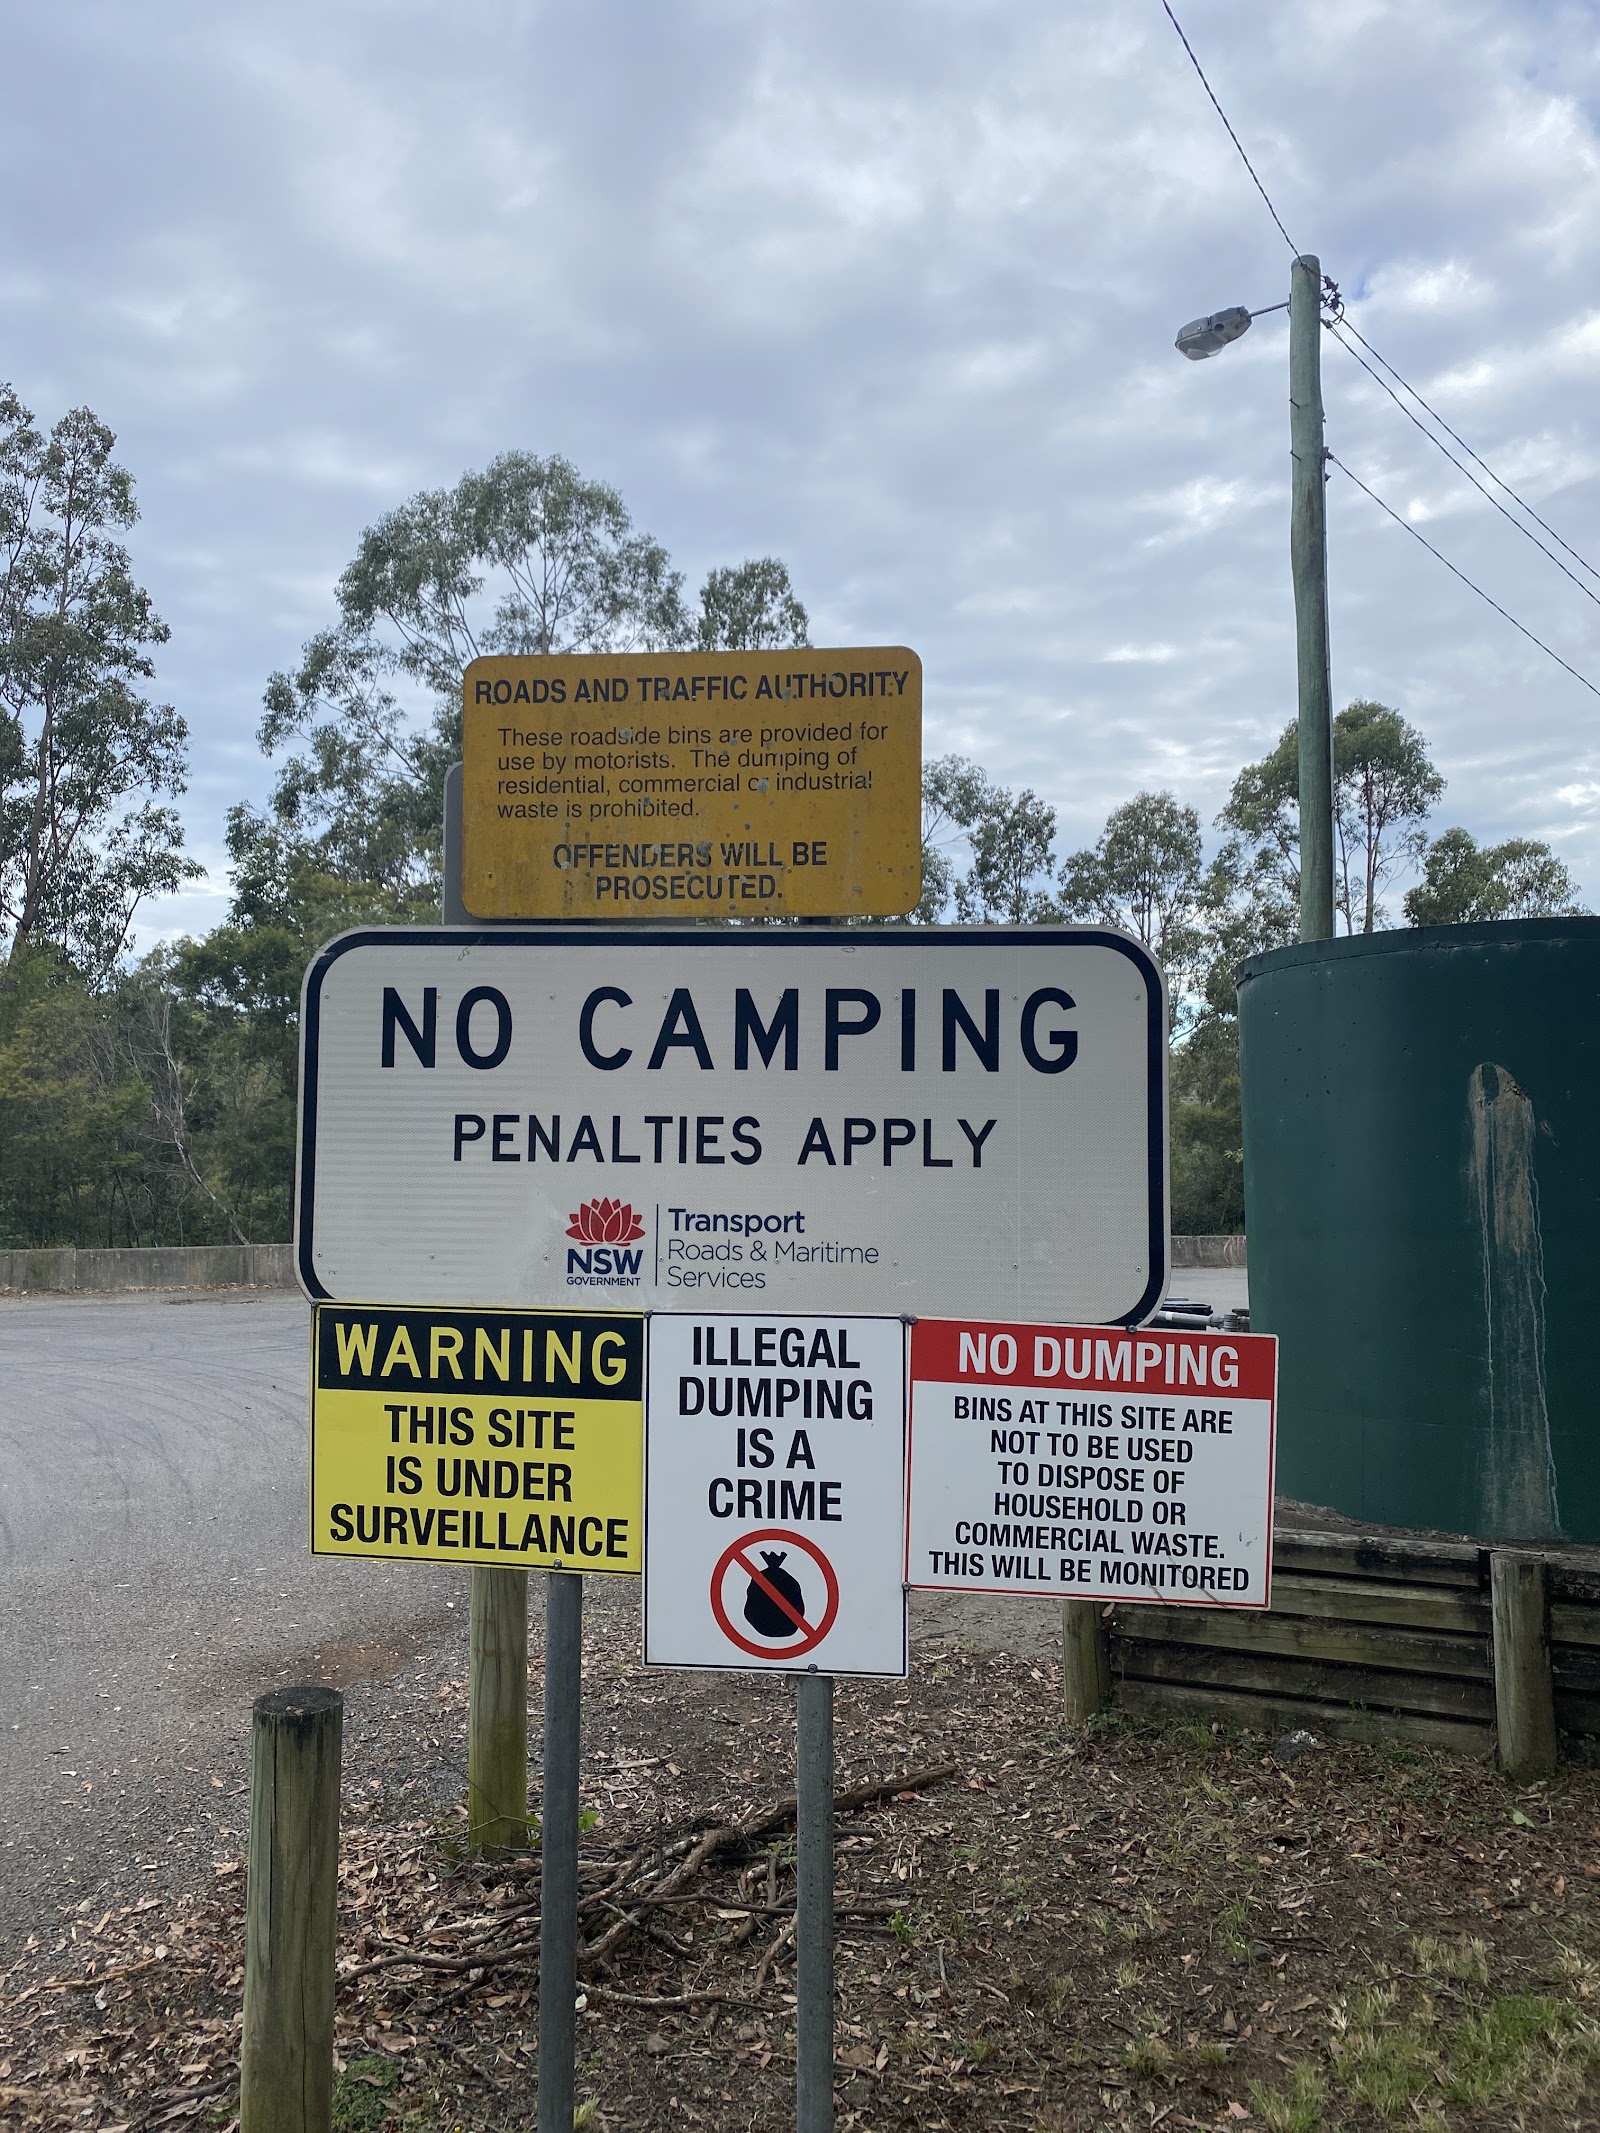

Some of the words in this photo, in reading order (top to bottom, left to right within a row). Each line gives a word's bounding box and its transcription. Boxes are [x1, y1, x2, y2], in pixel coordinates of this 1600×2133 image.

[475, 678, 566, 704] ROADS
[574, 678, 629, 702] AND
[636, 675, 747, 701] TRAFFIC
[755, 671, 908, 699] AUTHORITY
[498, 728, 562, 746] These
[571, 727, 660, 745] roadside
[668, 726, 710, 744] bins
[719, 726, 752, 743] are
[760, 722, 852, 746] provided
[860, 722, 888, 741] for
[498, 755, 535, 770] use
[543, 752, 566, 775] by
[574, 751, 675, 769] motorists.
[690, 750, 730, 768] The
[738, 748, 830, 772] dumping
[837, 747, 858, 766] of
[498, 775, 611, 796] residential,
[619, 773, 740, 793] commercial
[748, 776, 769, 791] o
[776, 771, 872, 791] industrial
[498, 803, 558, 818] waste
[566, 800, 582, 818] is
[590, 798, 699, 821] prohibited.
[553, 843, 712, 868] OFFENDERS
[720, 842, 783, 866] WILL
[793, 841, 827, 866] BE
[596, 875, 782, 900] PROSECUTED.
[381, 987, 513, 1070] NO
[579, 987, 1078, 1073] CAMPING
[454, 1115, 762, 1165] PENALTIES
[798, 1118, 997, 1168] APPLY
[668, 1208, 805, 1238] Transport
[567, 1248, 643, 1276] NSW
[668, 1240, 741, 1263] Roads
[749, 1241, 769, 1262] &
[775, 1241, 879, 1264] Maritime
[566, 1276, 640, 1286] GOVERNMENT
[668, 1265, 766, 1288] Services
[335, 1323, 627, 1385] WARNING
[693, 1327, 861, 1369] ILLEGAL
[959, 1332, 1017, 1376] NO
[1033, 1336, 1239, 1387] DUMPING
[679, 1377, 873, 1421] DUMPING
[954, 1396, 1014, 1422] BINS
[1019, 1399, 1051, 1423] AT
[1056, 1402, 1112, 1428] THIS
[1120, 1405, 1178, 1432] SITE
[1182, 1409, 1233, 1434] ARE
[384, 1405, 474, 1446] THIS
[488, 1409, 575, 1450] SITE
[736, 1428, 775, 1468] IS
[786, 1430, 815, 1470] A
[991, 1430, 1041, 1455] NOT
[1047, 1433, 1078, 1457] TO
[1086, 1436, 1119, 1459] BE
[1127, 1437, 1193, 1463] USED
[386, 1456, 423, 1495] IS
[437, 1459, 572, 1502] UNDER
[997, 1462, 1029, 1487] TO
[1038, 1465, 1145, 1491] DISPOSE
[1153, 1470, 1185, 1494] OF
[708, 1479, 842, 1521] CRIME
[994, 1492, 1144, 1523] HOUSEHOLD
[1152, 1500, 1186, 1526] OR
[330, 1504, 628, 1558] SURVEILLANCE
[955, 1522, 1125, 1553] COMMERCIAL
[1129, 1530, 1225, 1559] WASTE.
[929, 1550, 984, 1577] THIS
[990, 1555, 1051, 1581] WILL
[1059, 1558, 1091, 1582] BE
[1099, 1561, 1250, 1591] MONITORED
